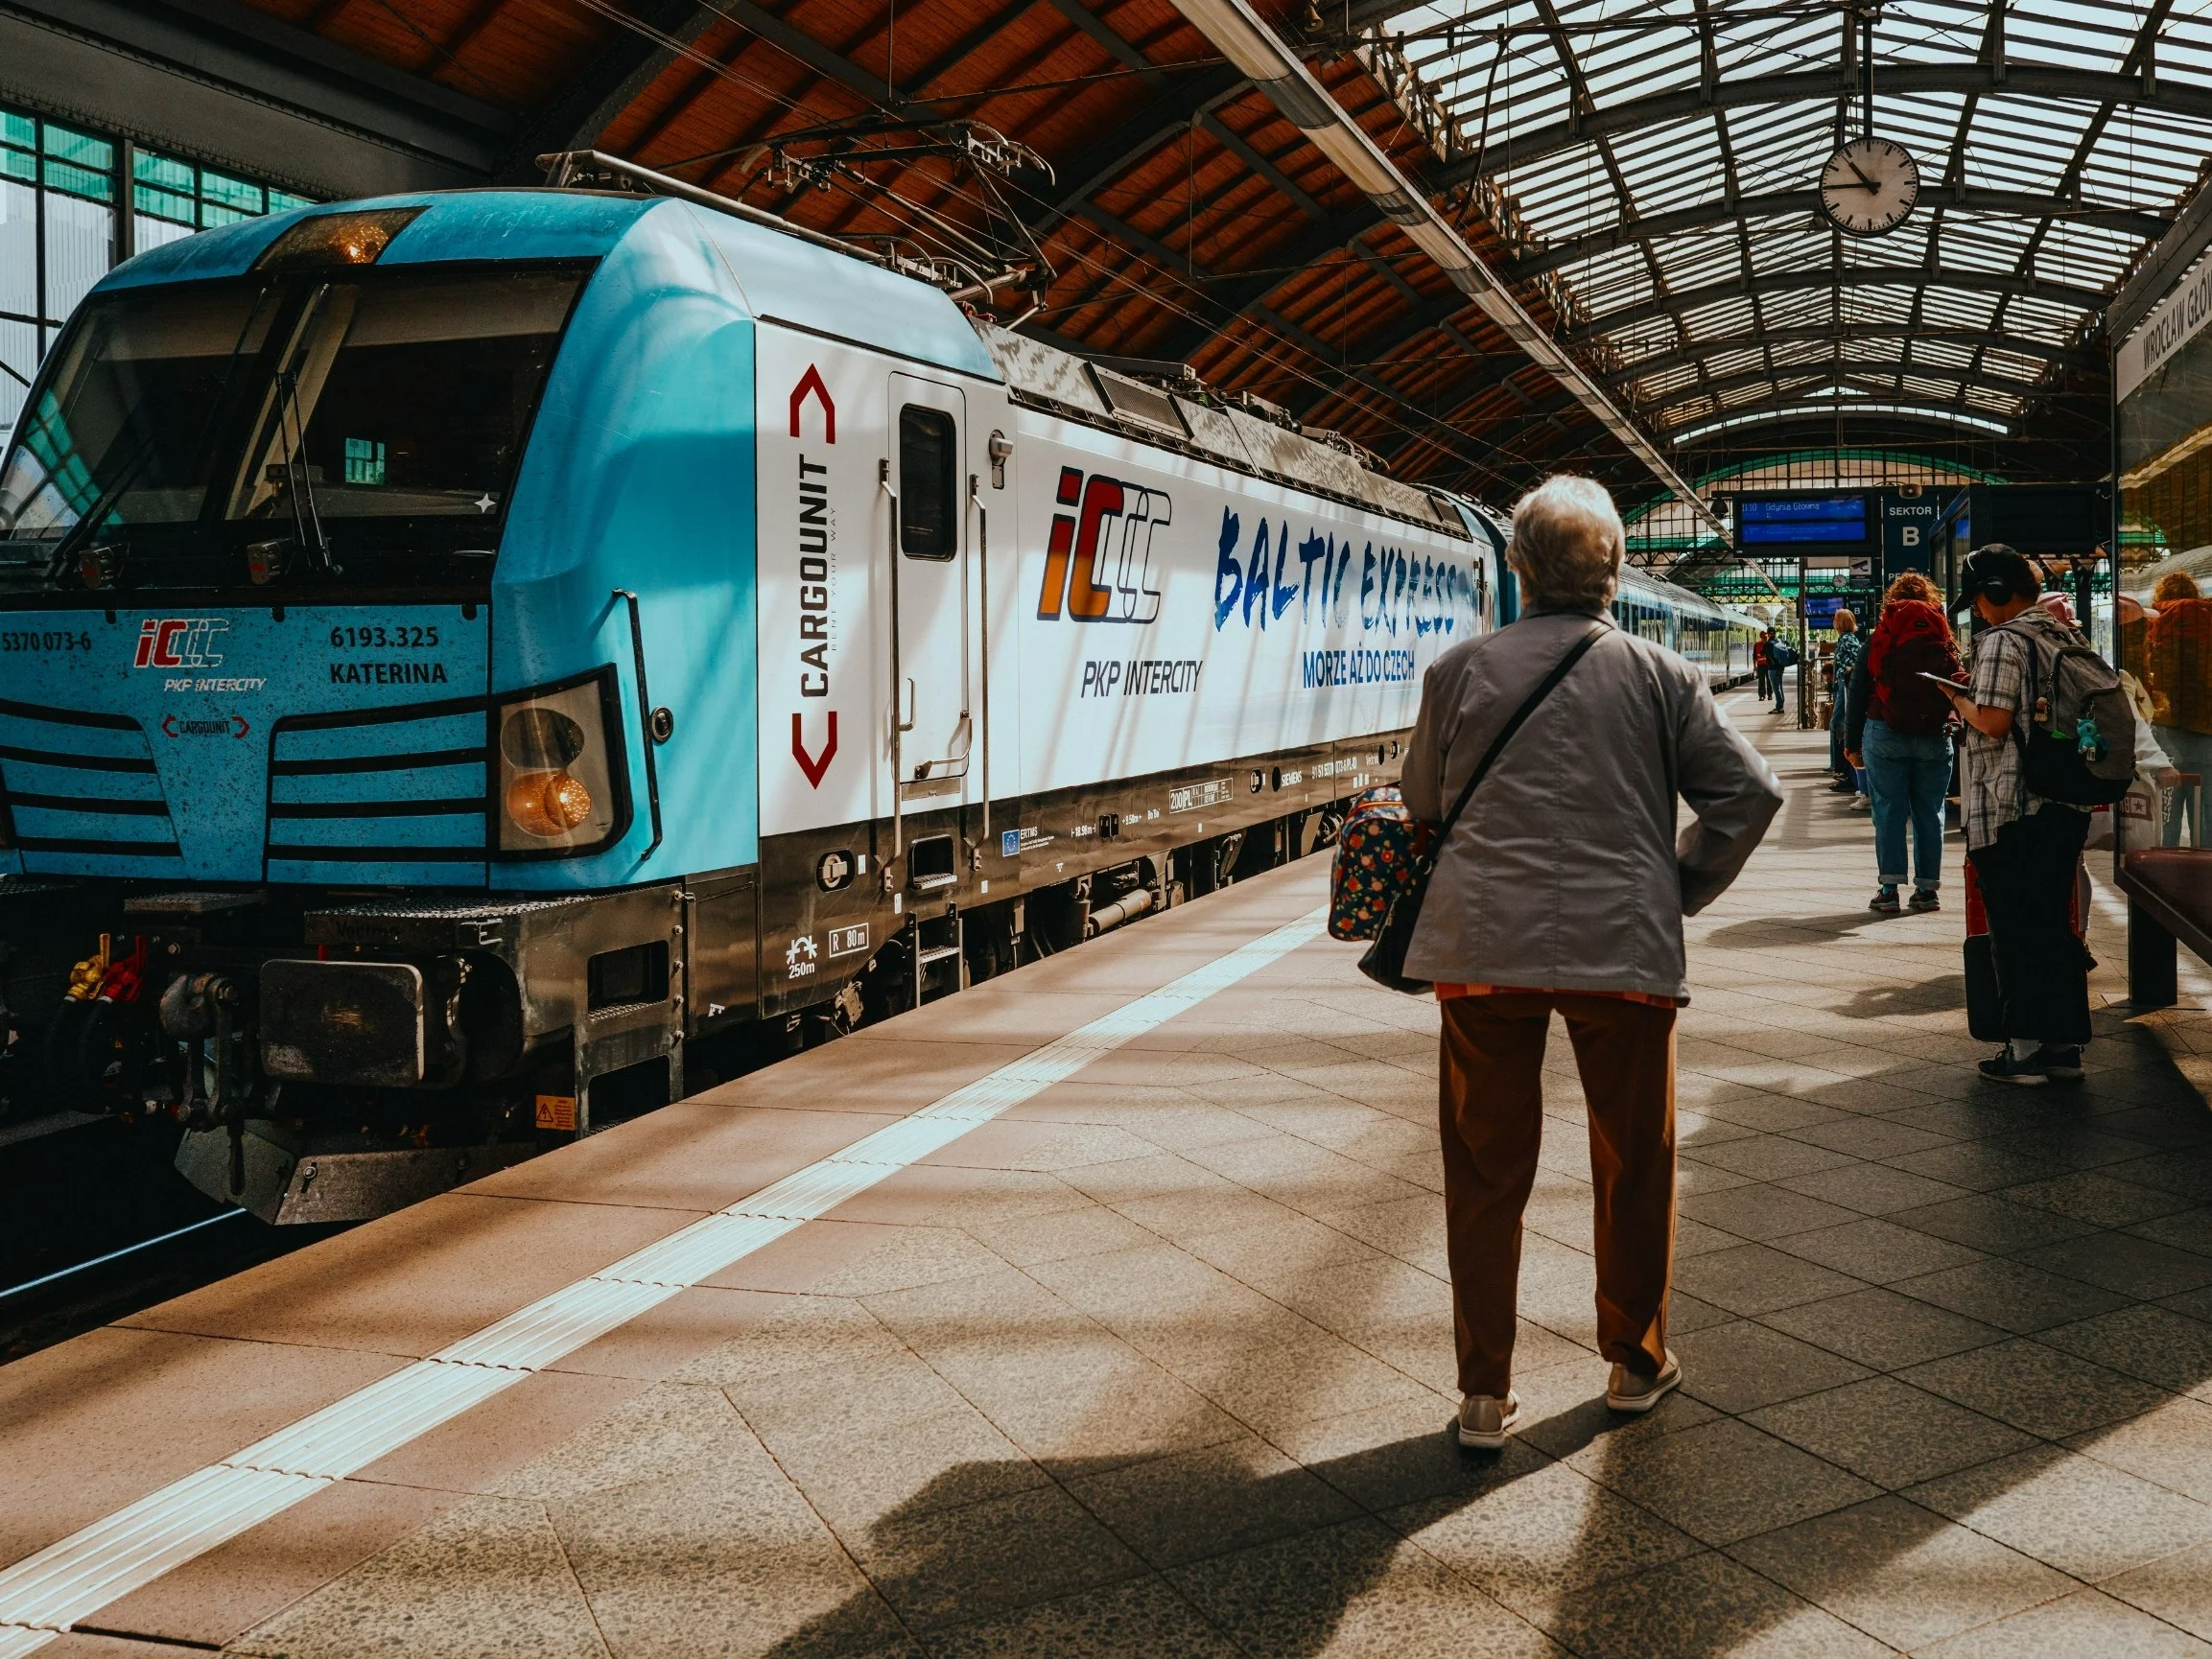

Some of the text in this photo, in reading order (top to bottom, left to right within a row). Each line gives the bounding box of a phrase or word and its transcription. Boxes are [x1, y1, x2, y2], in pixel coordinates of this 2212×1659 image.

[2143, 297, 2185, 370] WROCŁAW
[1889, 506, 1932, 516] SEKTOR
[1902, 526, 1920, 547] B
[799, 454, 829, 698] CARGOUNIT
[1214, 504, 1457, 639] BALTIC EXPRESS
[2, 631, 92, 651] 5370 073-6
[330, 626, 439, 648] 6193.325
[330, 663, 448, 684] KATERINA
[1303, 642, 1415, 689] MORZE AŻ DO CZECH
[164, 677, 268, 692] PKP INTERCITY
[1081, 660, 1203, 698] PKP INTERCITY
[179, 720, 231, 735] CARGOUNIT
[1282, 770, 1303, 786] SIEMENS
[1170, 791, 1183, 810] 200
[1020, 826, 1038, 839] ERTMS
[833, 933, 839, 952] R
[788, 962, 815, 980] 250m
